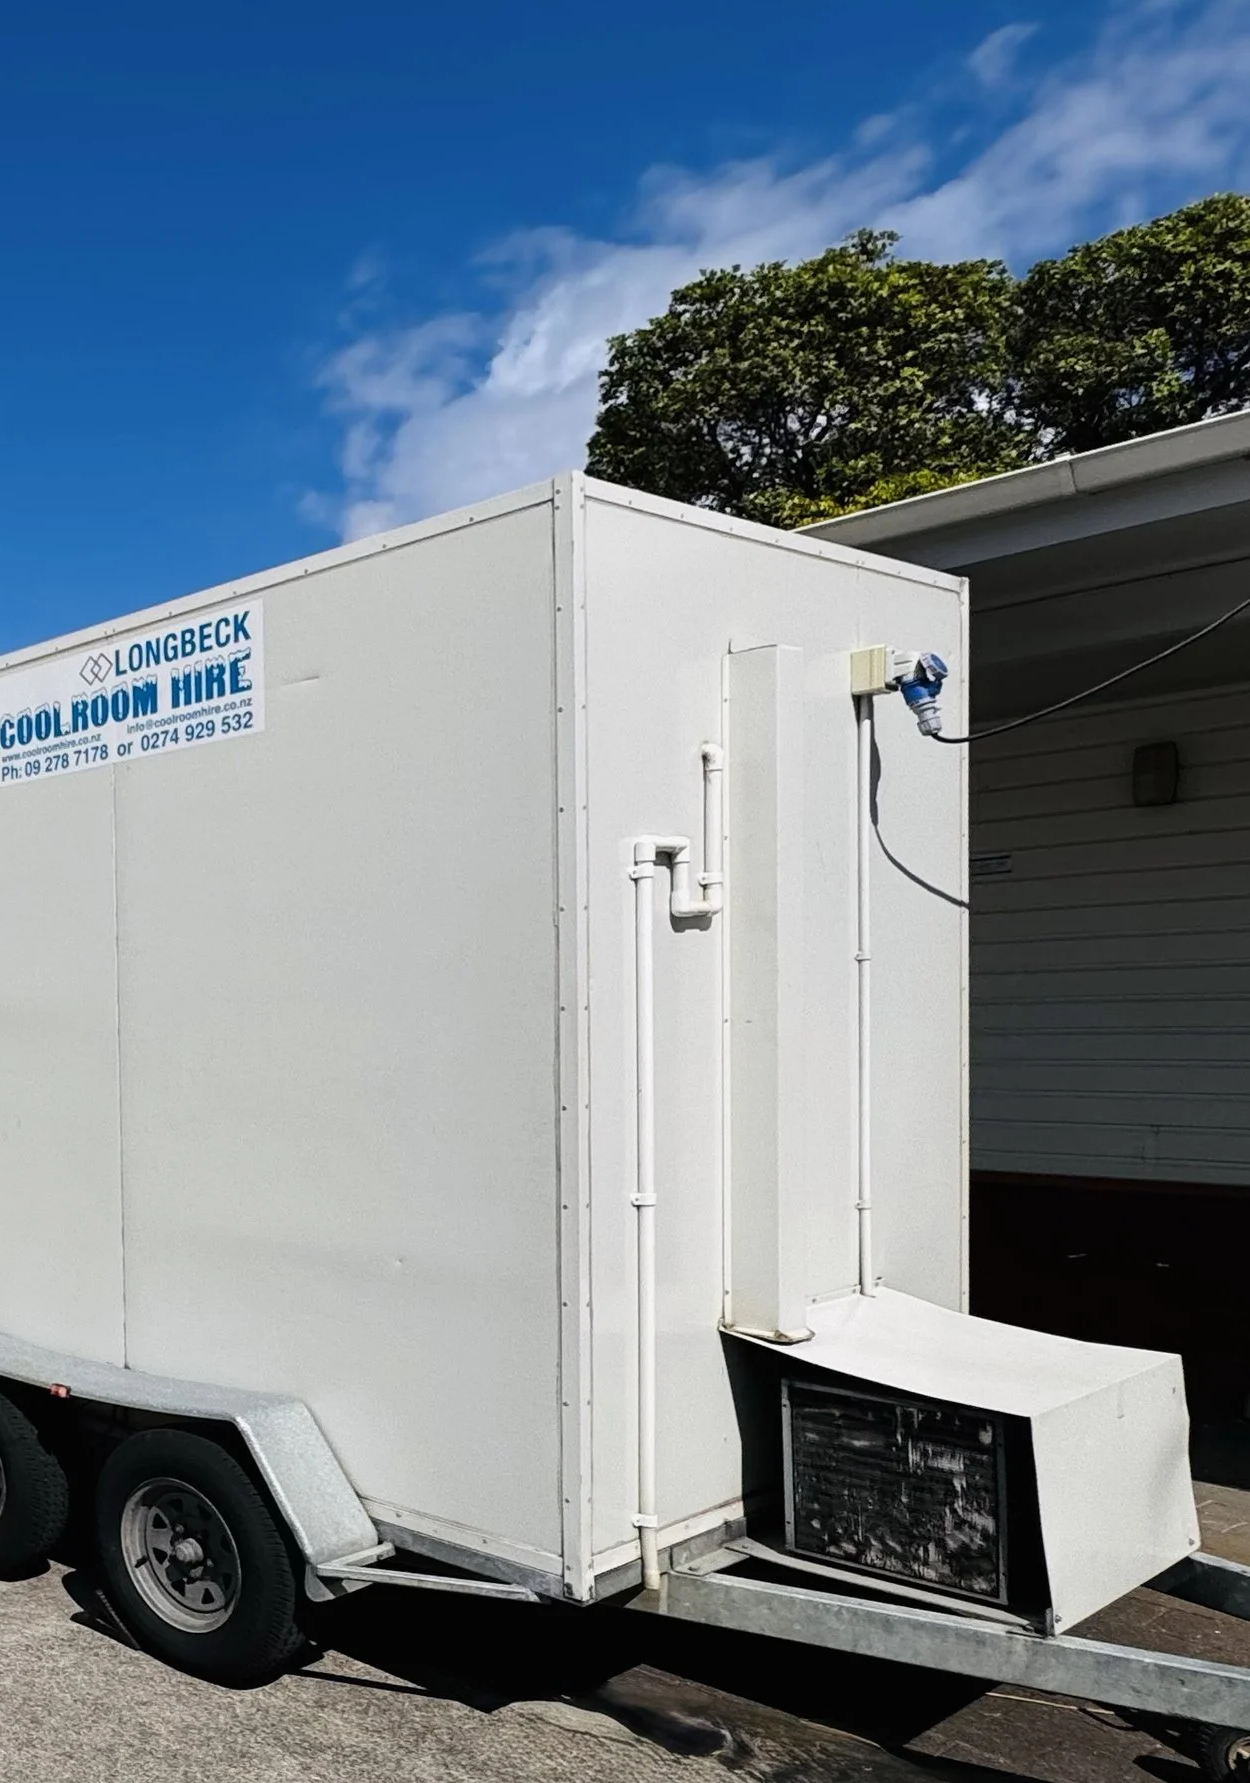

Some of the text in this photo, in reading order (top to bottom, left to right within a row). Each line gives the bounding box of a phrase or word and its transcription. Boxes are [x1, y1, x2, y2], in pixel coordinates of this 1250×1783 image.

[114, 610, 251, 676] LONGBECK
[0, 647, 252, 750] COOLROOM HIRE
[126, 697, 253, 734] info@coolroomhire.co.nz
[1, 710, 254, 782] Ph: 09 278 7178 or 0274 929 532
[1, 733, 102, 763] www.coolroomhire.co.nz
